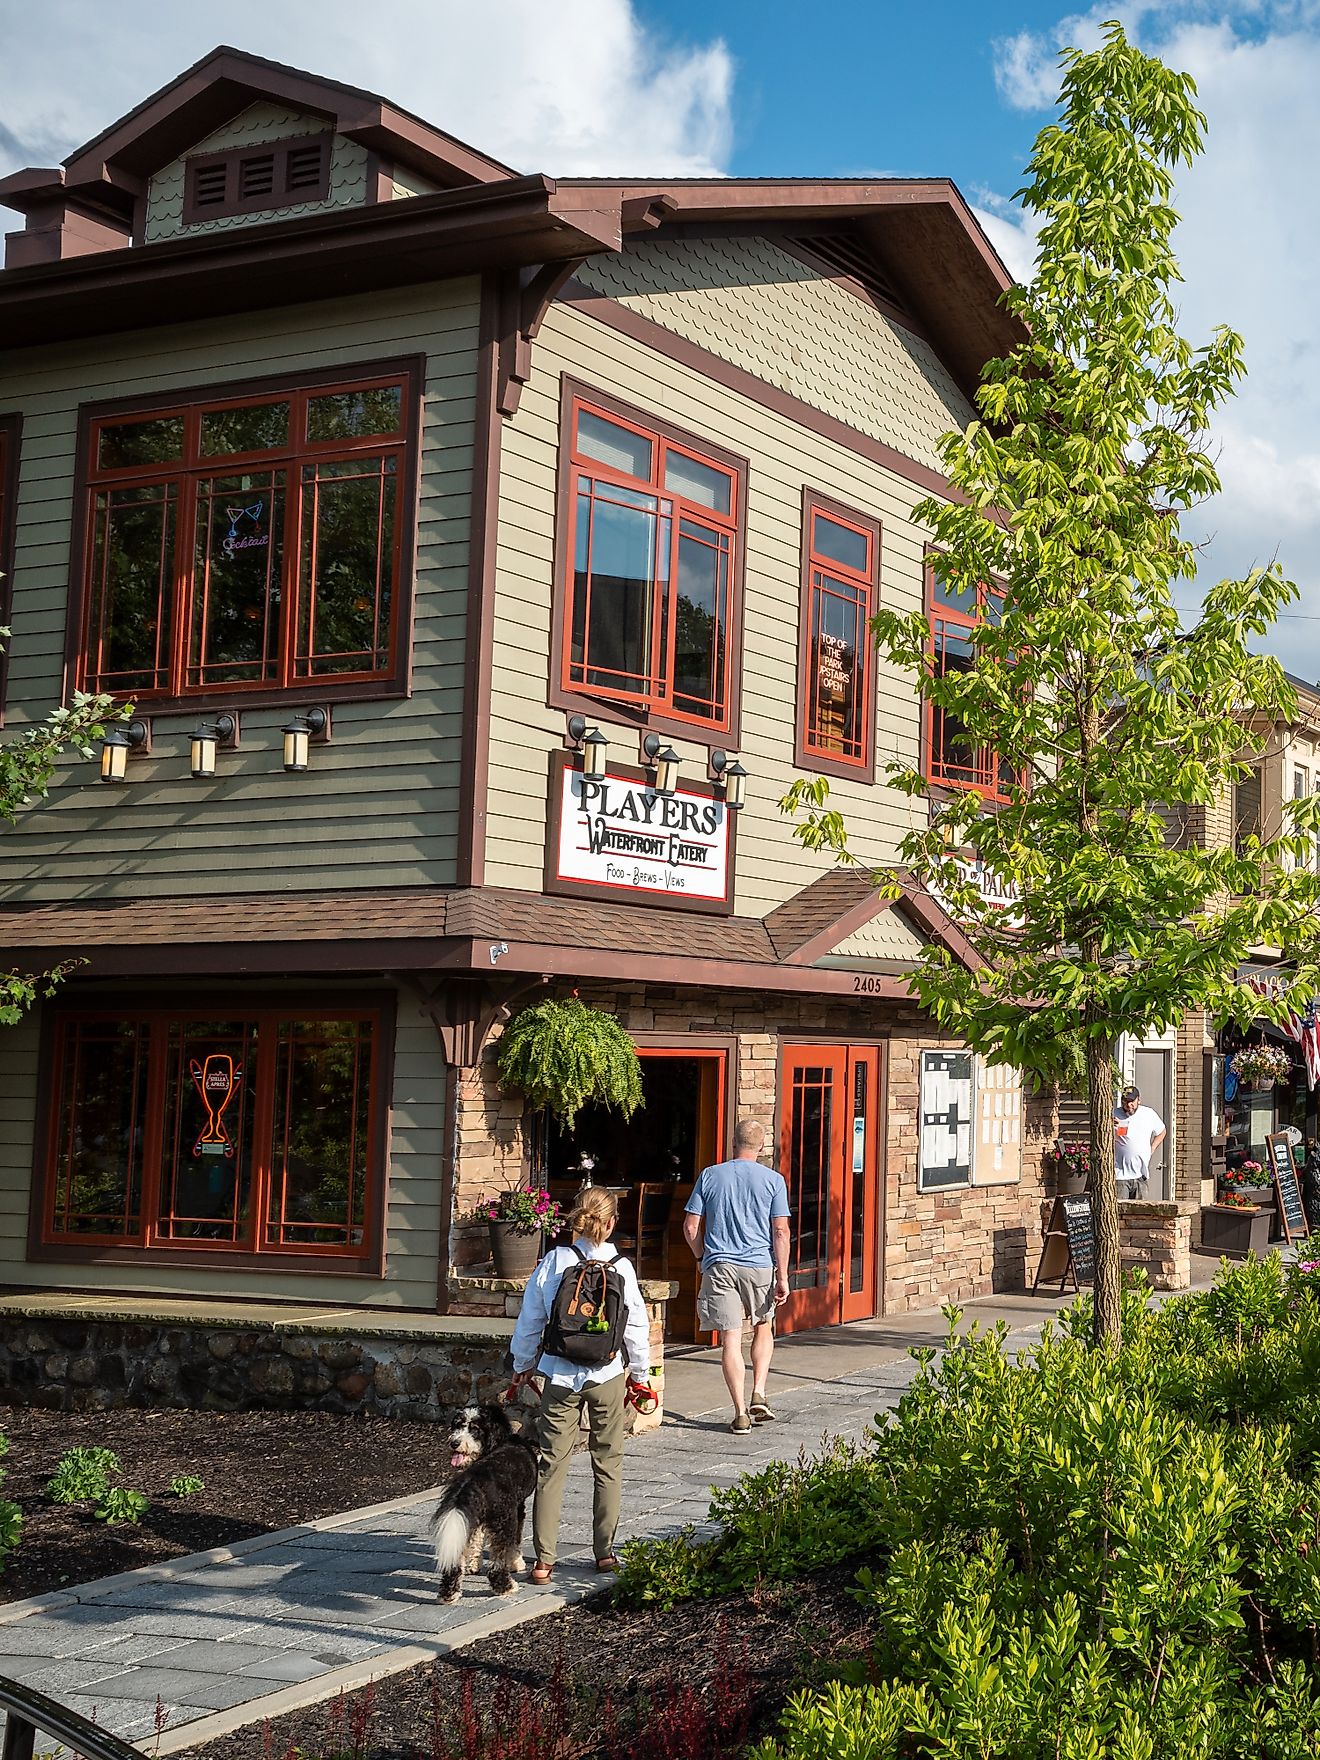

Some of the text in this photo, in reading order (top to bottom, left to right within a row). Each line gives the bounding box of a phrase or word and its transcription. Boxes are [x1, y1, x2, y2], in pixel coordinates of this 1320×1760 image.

[821, 632, 848, 649] TOP OF
[827, 646, 841, 660] THE
[824, 655, 843, 671] PARK
[823, 677, 843, 692] OPEN
[577, 779, 717, 835] PLAYERS
[586, 814, 709, 867] WATERFRONT EATERY
[853, 976, 881, 993] 2405
